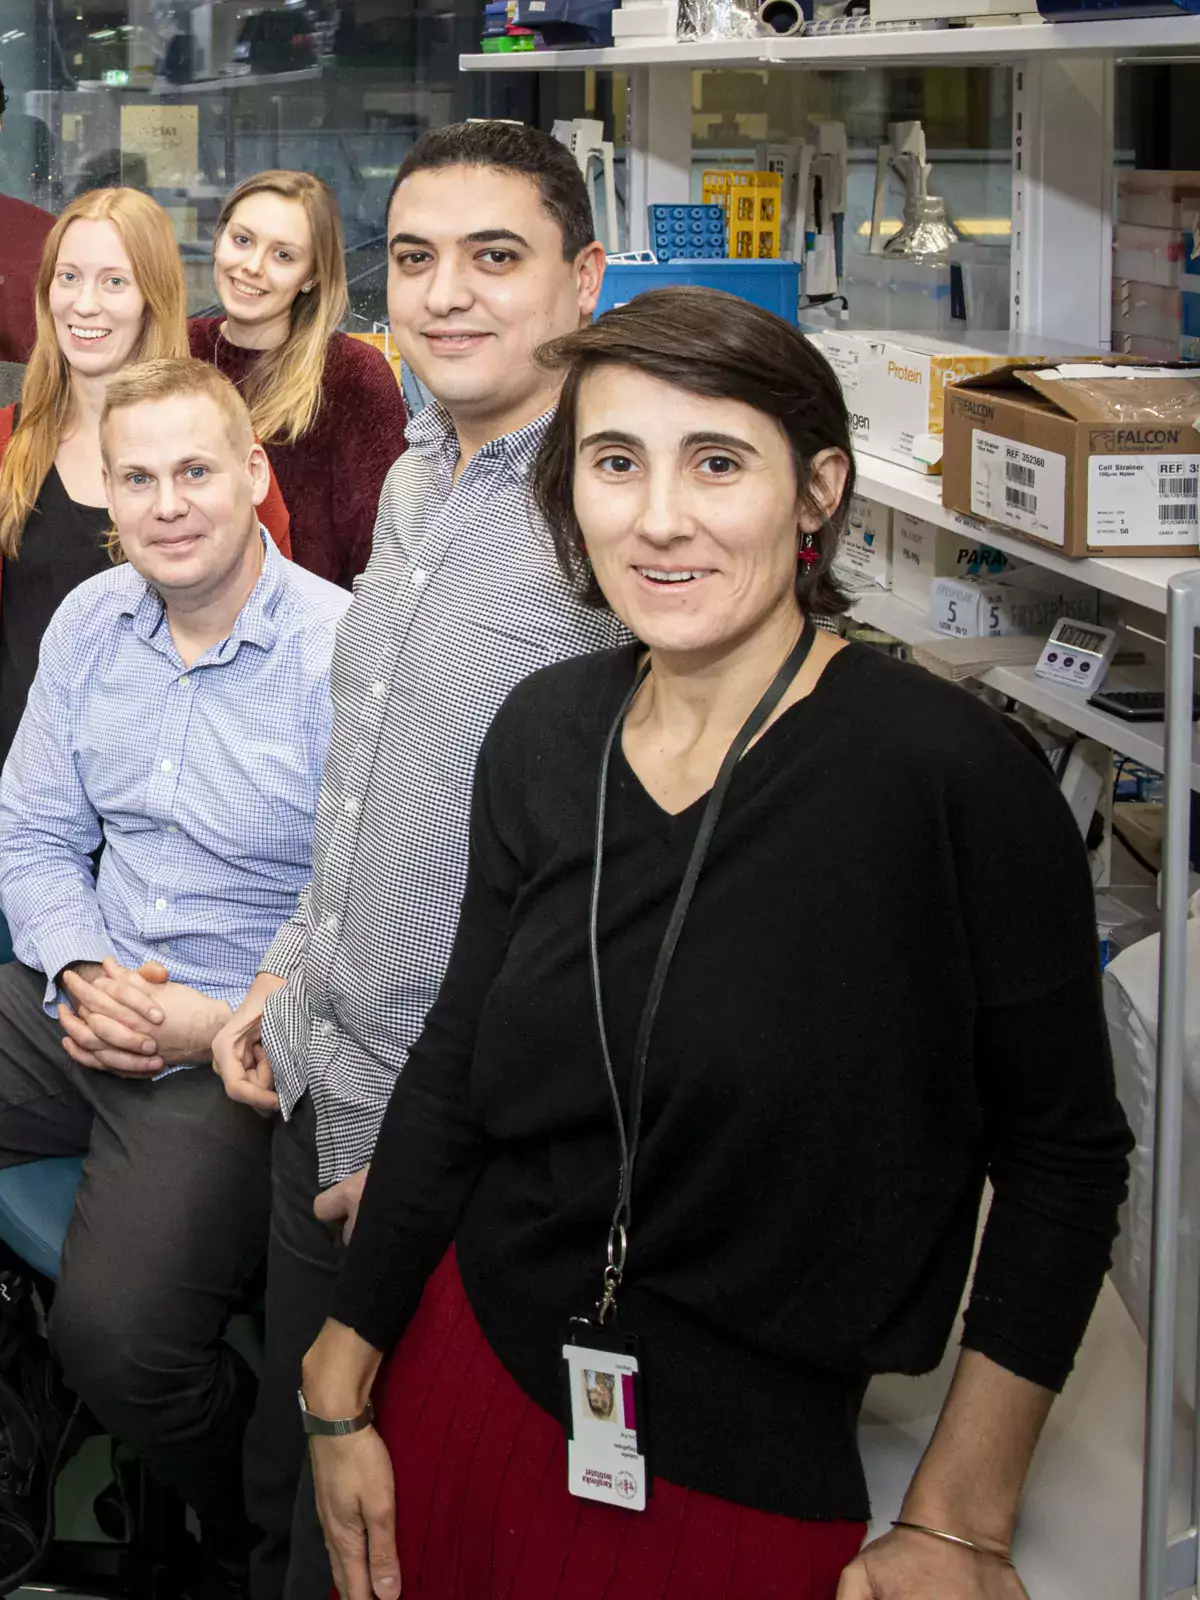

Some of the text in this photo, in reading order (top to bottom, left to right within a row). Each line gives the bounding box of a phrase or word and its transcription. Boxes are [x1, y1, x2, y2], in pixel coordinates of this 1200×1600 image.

[887, 360, 922, 384] Protein
[964, 399, 995, 421] FALCON
[1116, 429, 1179, 444] FALCON
[1006, 447, 1020, 460] REF
[1021, 452, 1045, 468] 352360
[1160, 463, 1184, 474] REF
[1120, 527, 1129, 535] 50
[947, 601, 958, 623] 5
[988, 606, 1000, 630] 5
[582, 1474, 613, 1490] Karolinska
[585, 1467, 613, 1482] Institutet
